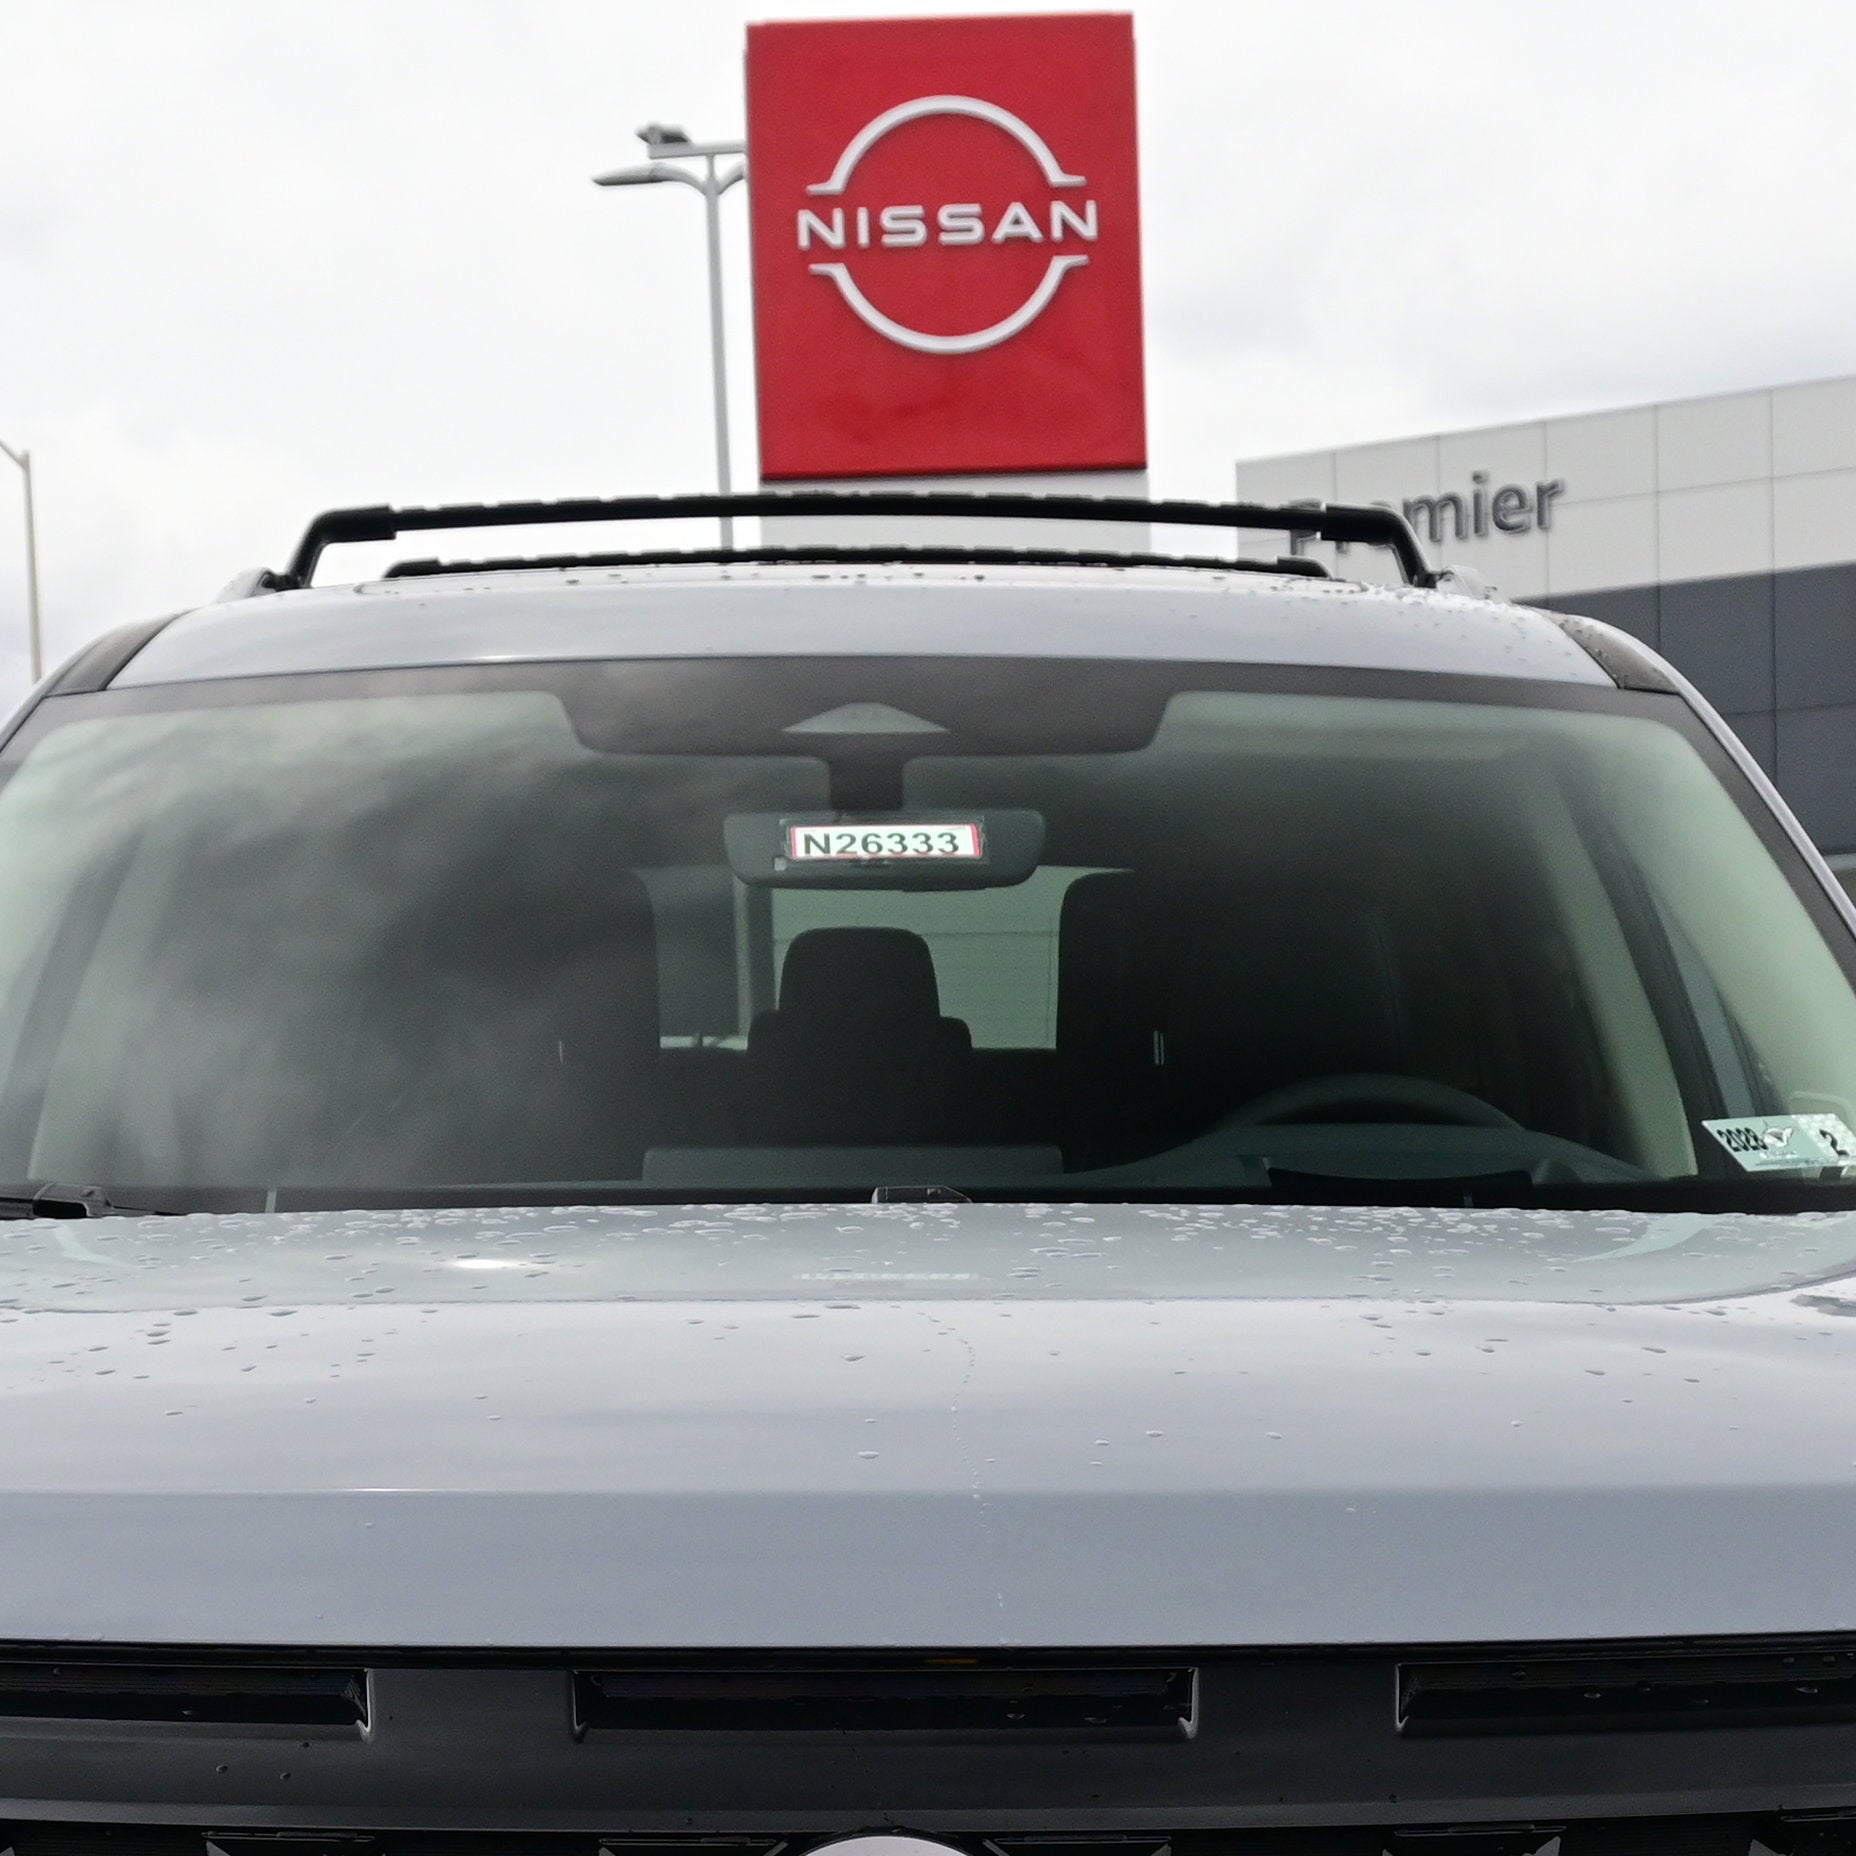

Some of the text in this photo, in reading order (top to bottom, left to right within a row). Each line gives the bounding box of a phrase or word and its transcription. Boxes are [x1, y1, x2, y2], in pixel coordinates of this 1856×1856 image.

[796, 200, 1098, 250] NISSAN
[1290, 470, 1565, 556] mier
[803, 831, 960, 856] N26333
[1818, 1128, 1850, 1157] 2
